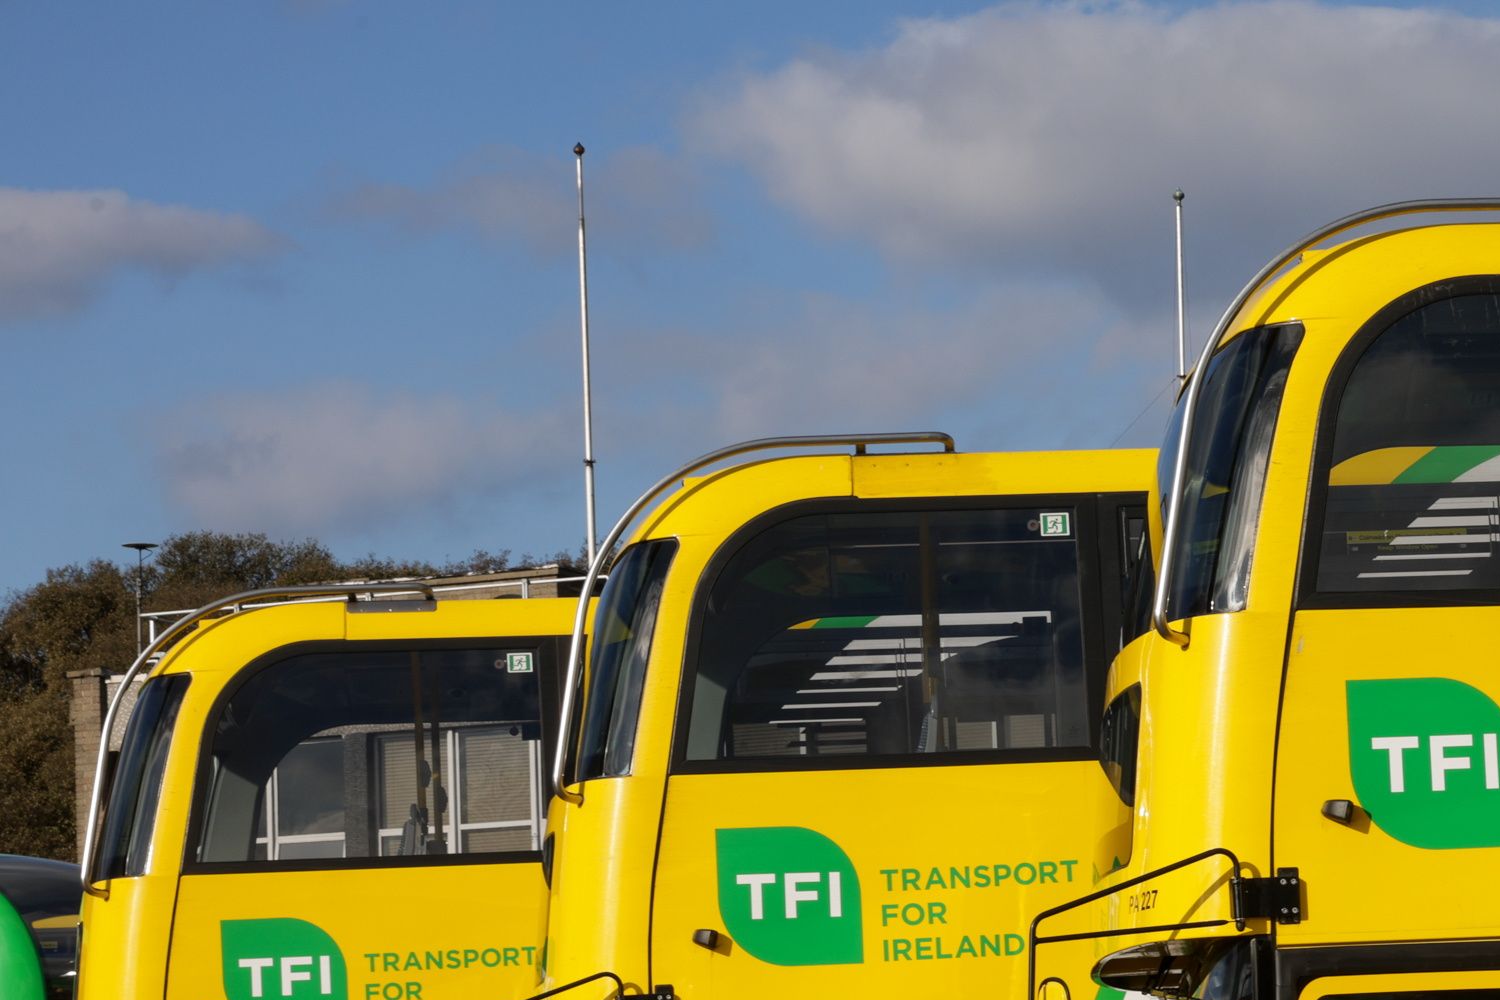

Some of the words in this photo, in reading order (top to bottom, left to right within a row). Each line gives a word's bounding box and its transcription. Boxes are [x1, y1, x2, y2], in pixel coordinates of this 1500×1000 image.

[1371, 733, 1500, 793] TFI
[880, 859, 1078, 891] TRANSPORT
[736, 872, 842, 920] TFI
[1141, 890, 1158, 910] 227
[881, 902, 948, 927] FOR
[364, 946, 537, 972] TRANSPORT
[882, 933, 1025, 962] IRELAND
[238, 955, 332, 998] TFI
